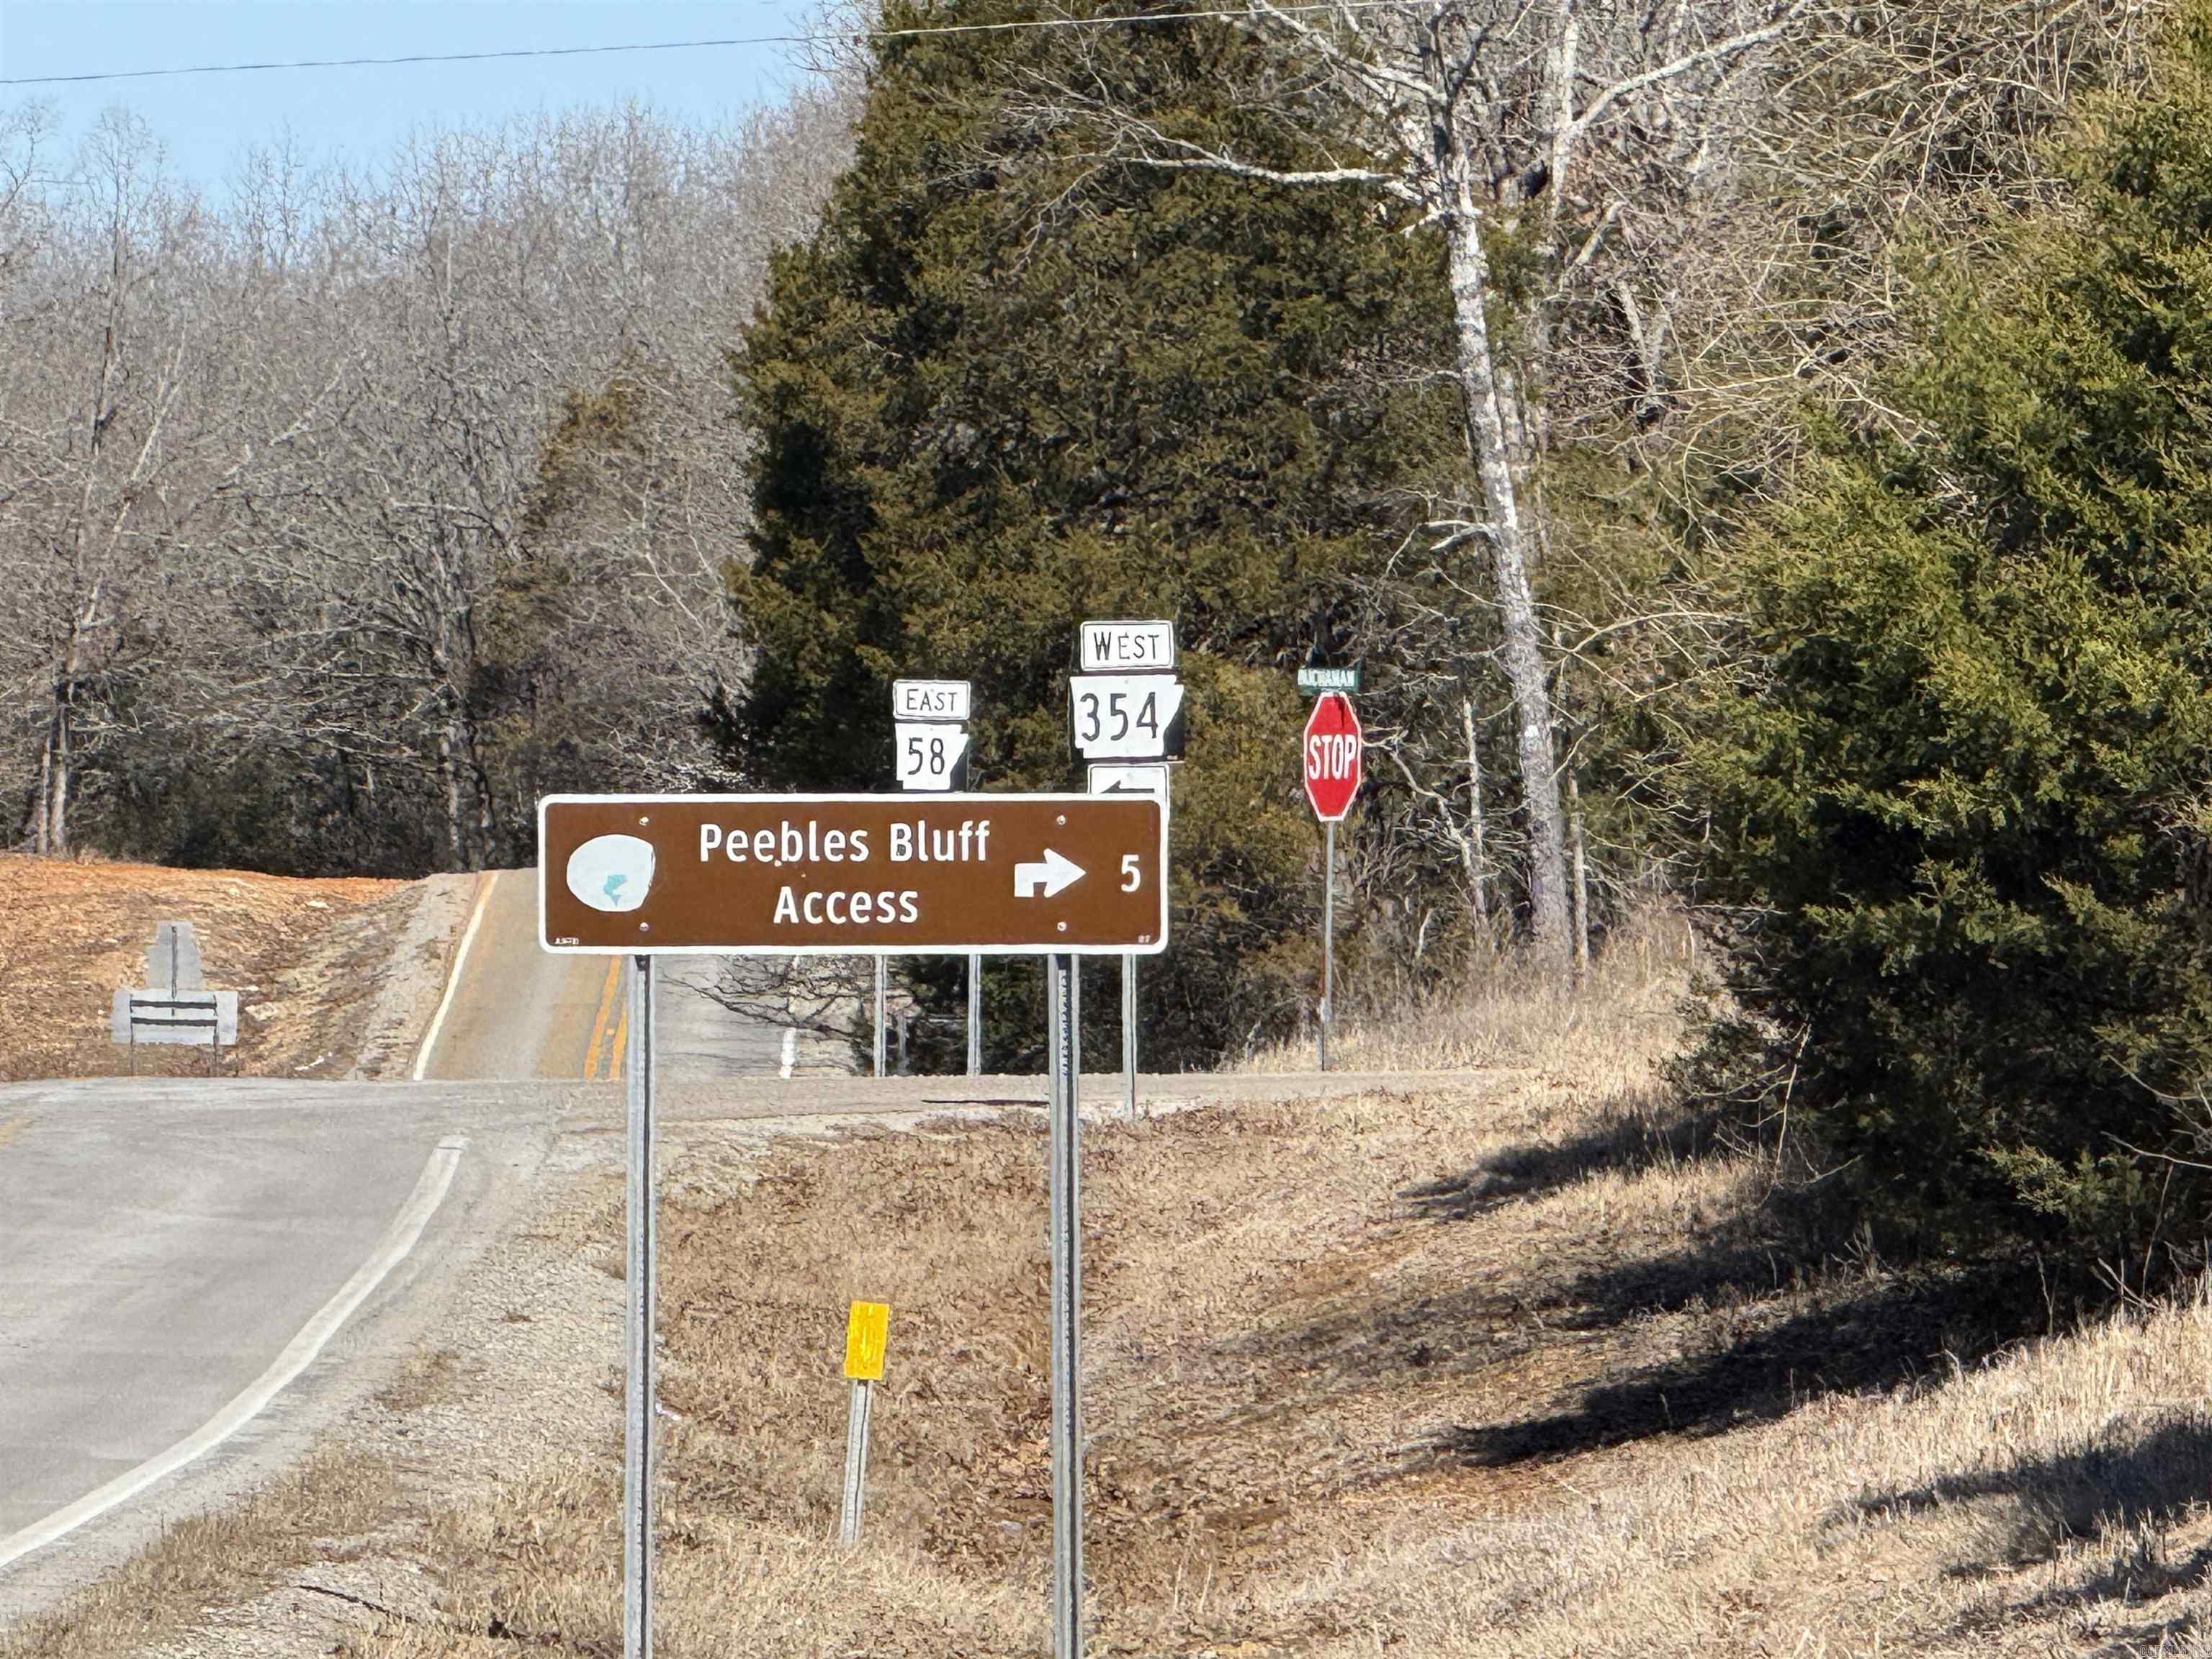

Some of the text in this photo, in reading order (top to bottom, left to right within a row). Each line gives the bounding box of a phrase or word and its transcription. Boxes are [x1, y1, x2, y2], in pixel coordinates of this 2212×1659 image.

[1094, 631, 1159, 661] WEST
[906, 688, 958, 711] EAST
[1080, 691, 1159, 742] 354
[907, 737, 945, 775] 58
[1308, 734, 1357, 781] STOP
[700, 820, 991, 863] Peebles Bluff
[1121, 854, 1141, 893] 5
[773, 886, 919, 925] Access
